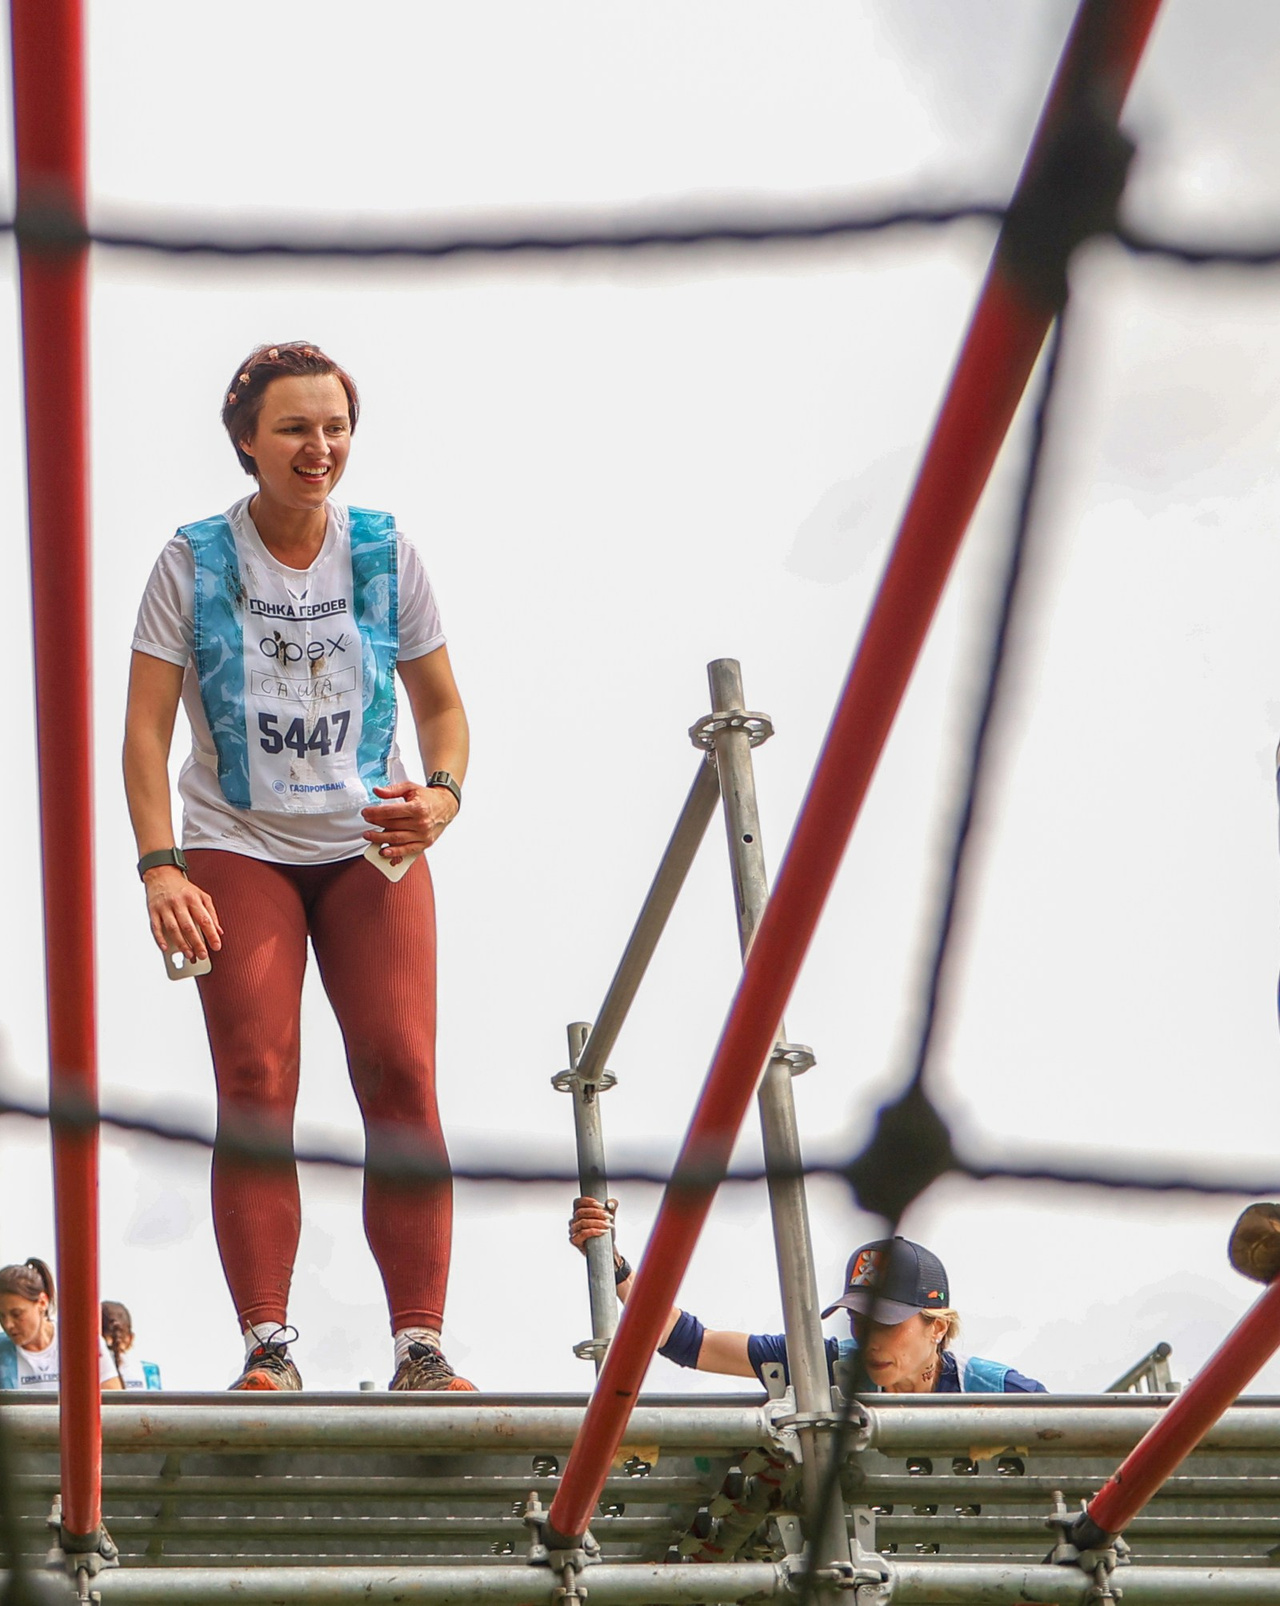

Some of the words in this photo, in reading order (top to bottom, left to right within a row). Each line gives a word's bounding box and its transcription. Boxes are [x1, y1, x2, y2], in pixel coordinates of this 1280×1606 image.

[249, 598, 296, 617] ГОНКА
[299, 598, 347, 616] ГЕРОЕВ
[259, 633, 346, 666] apex
[258, 710, 351, 758] 5447
[289, 781, 347, 794] ГАЗПРОМБАНК
